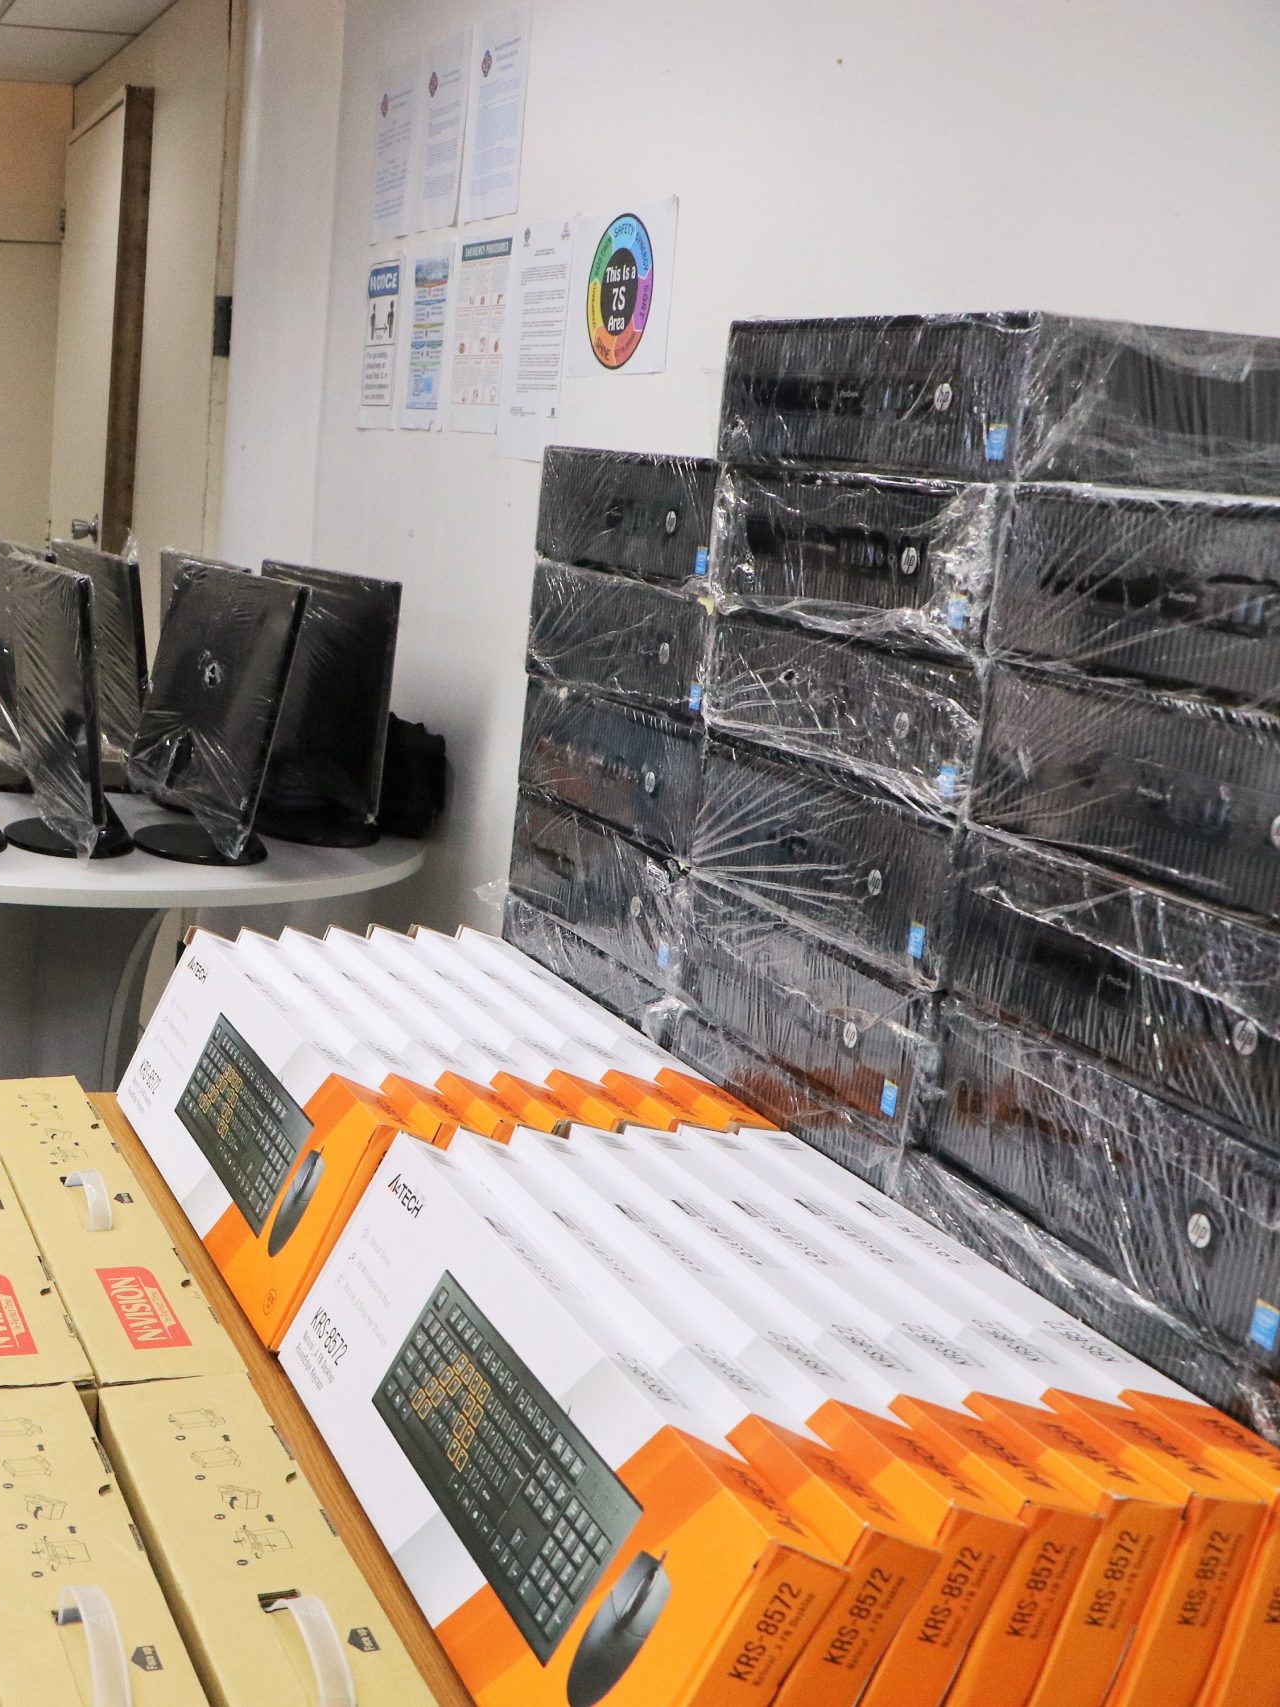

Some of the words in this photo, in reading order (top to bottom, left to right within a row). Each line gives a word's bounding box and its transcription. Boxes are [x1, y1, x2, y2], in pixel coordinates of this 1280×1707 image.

[614, 222, 636, 239] SAFETY
[606, 265, 621, 283] This
[612, 286, 626, 311] 7S
[608, 316, 625, 331] Area
[935, 384, 952, 411] hp
[902, 547, 917, 575] hp
[868, 869, 883, 896] hp
[844, 1021, 857, 1048] hp
[1188, 1213, 1211, 1249] hp
[310, 1306, 348, 1366] KRS-8572
[1006, 1540, 1065, 1638] KRS-8572
[1086, 1530, 1141, 1629] KRS-8572
[1178, 1530, 1229, 1629] KRS-8572
[917, 1546, 981, 1647] KRS-8572
[728, 1581, 802, 1682] KRS-8572
[824, 1567, 892, 1668] KRS-8572
